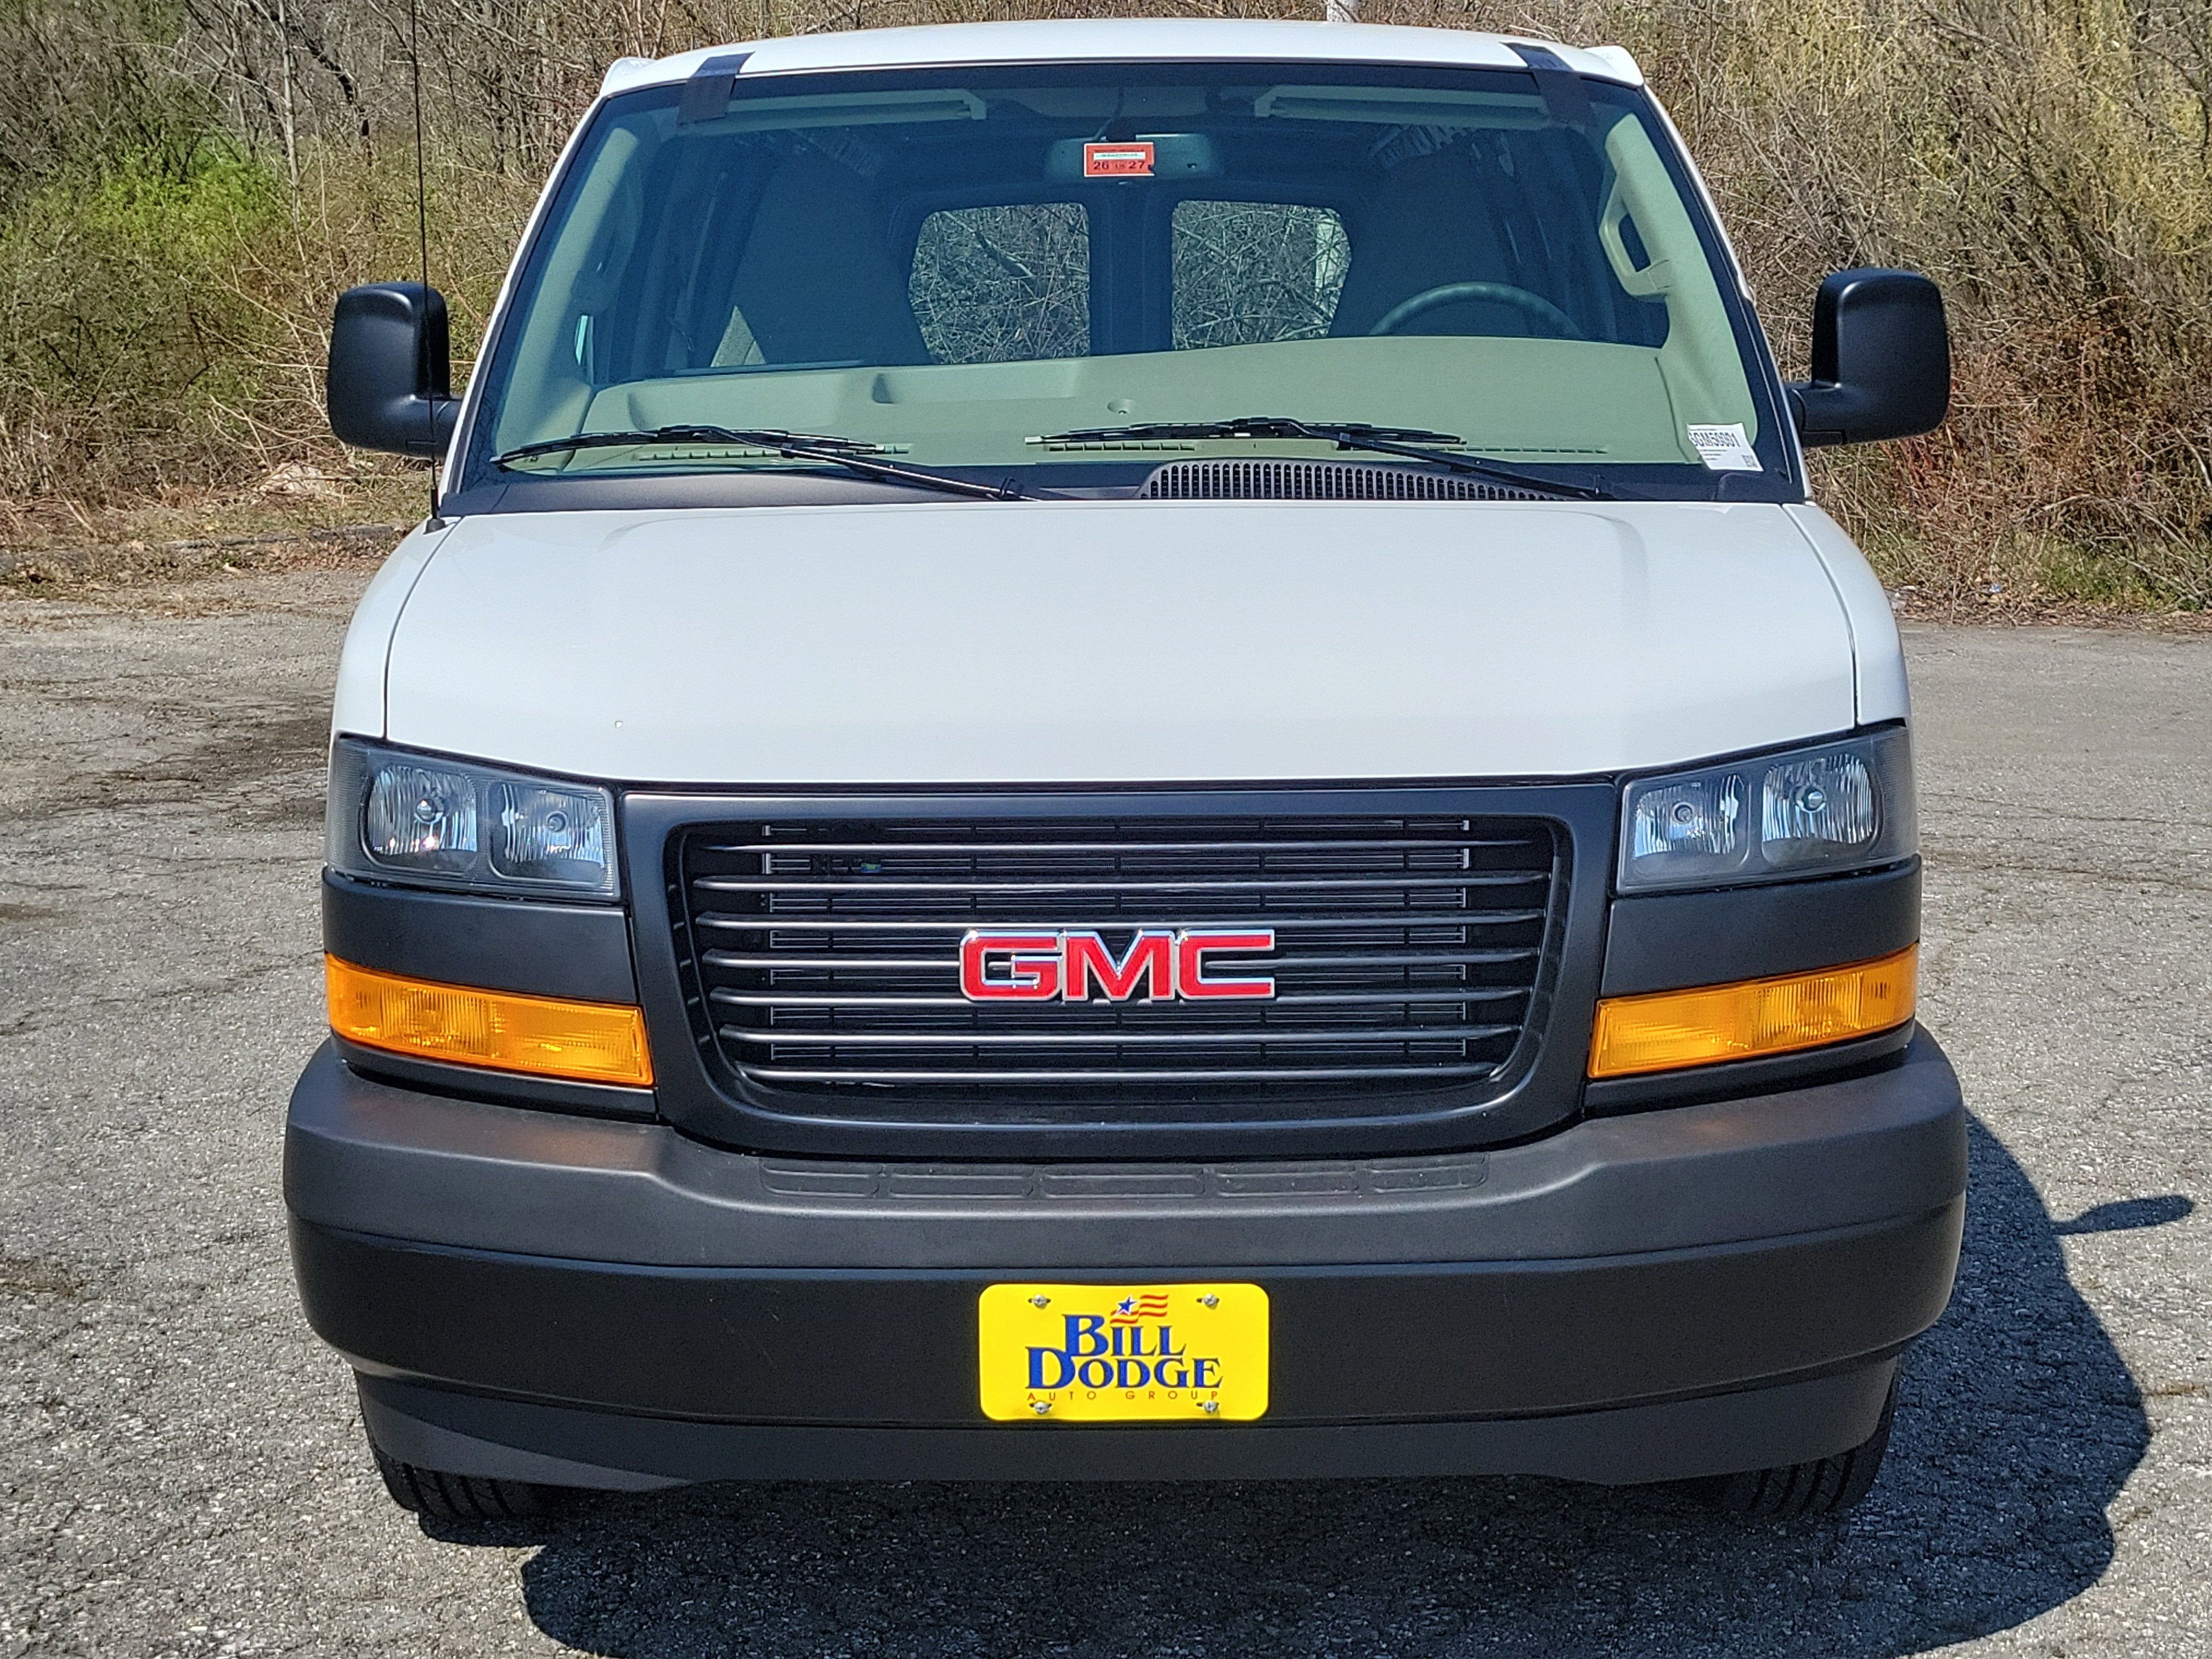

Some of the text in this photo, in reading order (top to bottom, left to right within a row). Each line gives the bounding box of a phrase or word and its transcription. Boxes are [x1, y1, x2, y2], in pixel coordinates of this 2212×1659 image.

[1093, 161, 1109, 170] 26
[1128, 160, 1146, 169] 27
[960, 929, 1275, 1000] GMC
[1062, 1313, 1186, 1357] BILL
[1025, 1346, 1223, 1389] DODGE
[1026, 1390, 1218, 1402] AUTO GROUP
